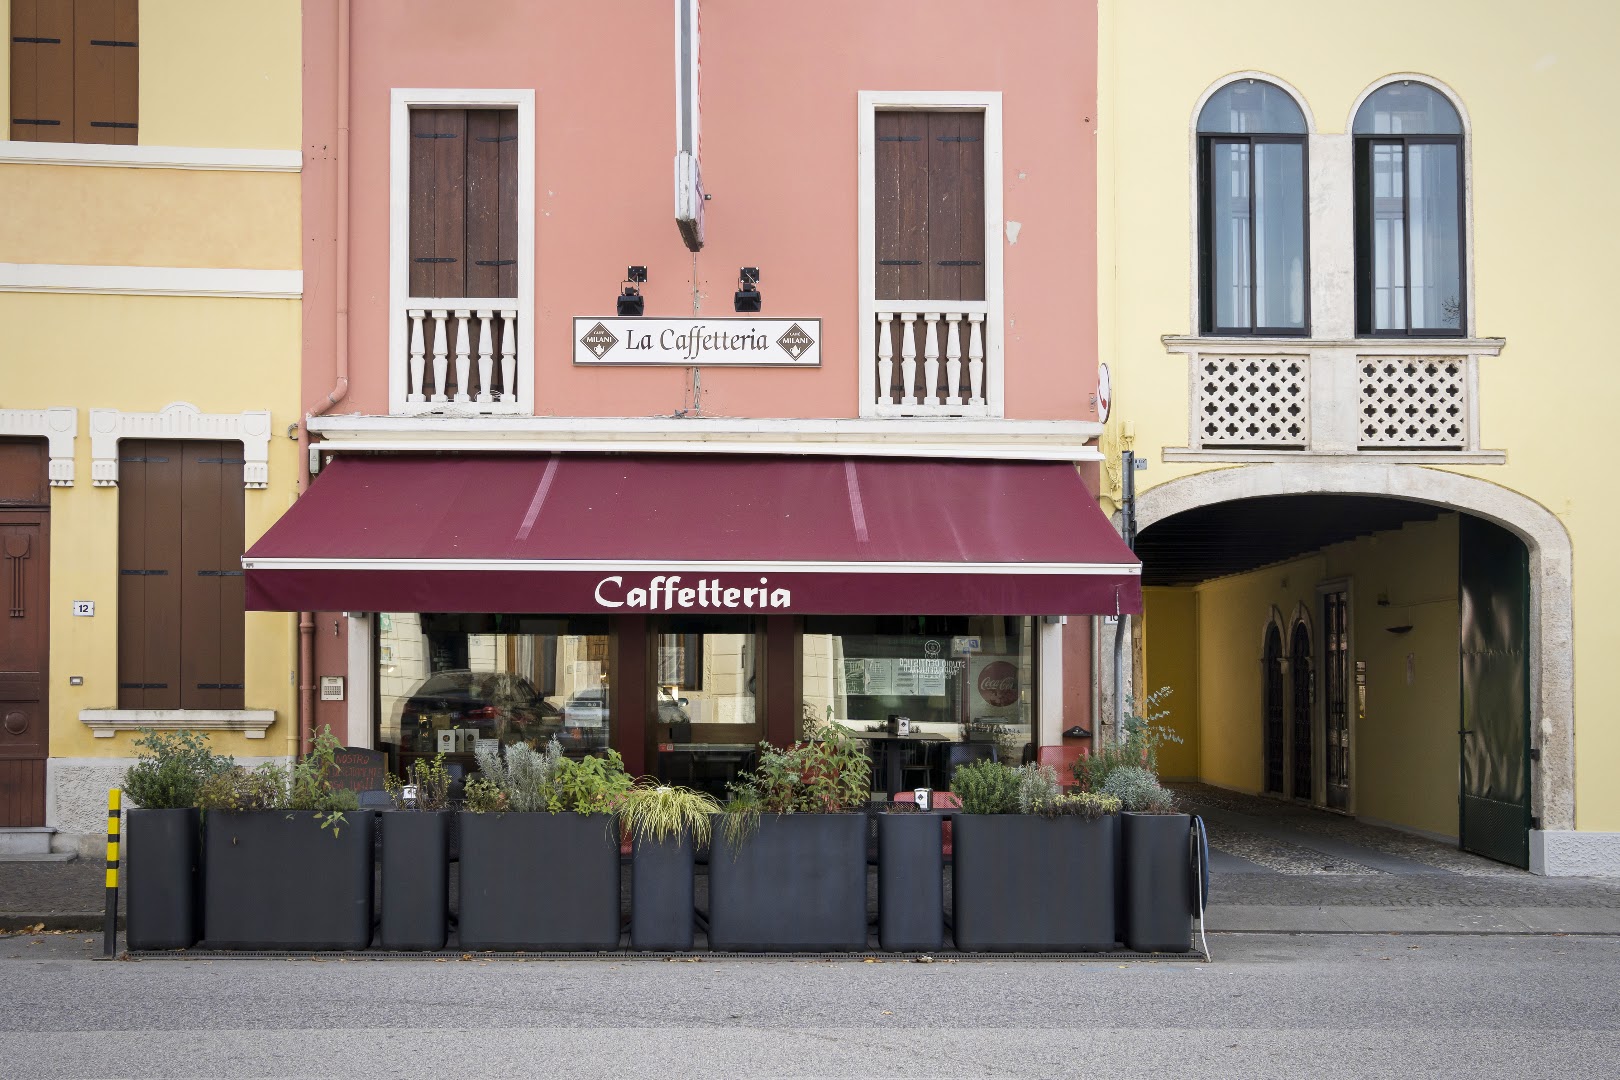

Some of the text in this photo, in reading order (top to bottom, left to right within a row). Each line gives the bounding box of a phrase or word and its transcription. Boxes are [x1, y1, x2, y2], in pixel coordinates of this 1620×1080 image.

[625, 325, 770, 360] La Caffetteria
[78, 604, 89, 613] 12
[594, 575, 791, 611] Caffetteria
